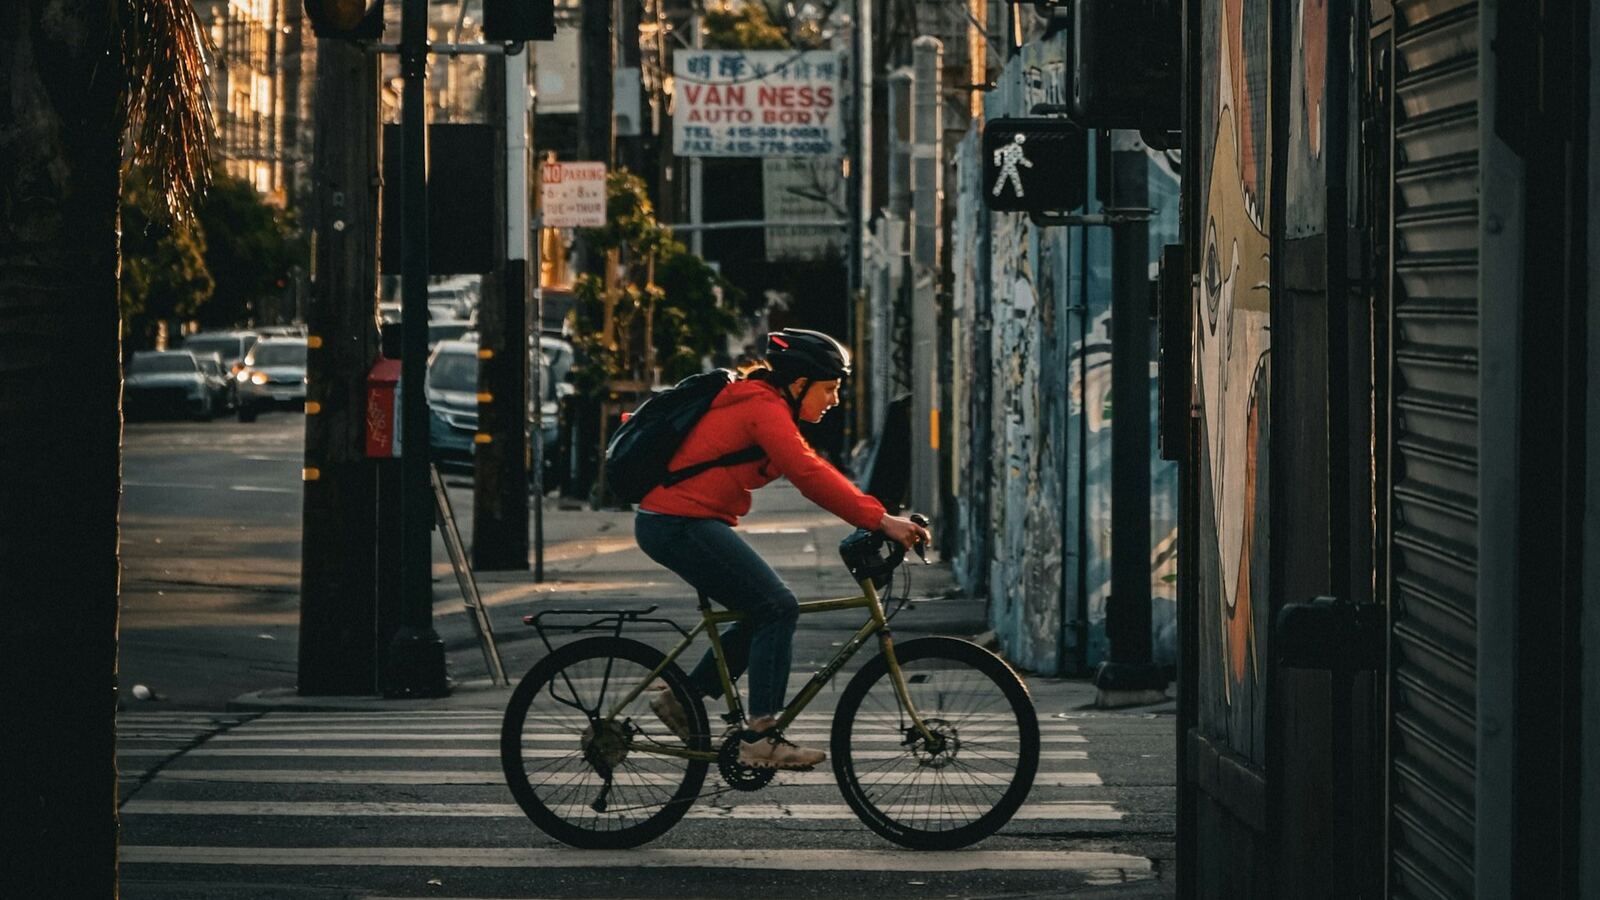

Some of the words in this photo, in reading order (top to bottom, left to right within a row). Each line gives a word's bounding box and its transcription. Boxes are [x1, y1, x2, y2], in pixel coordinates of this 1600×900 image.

[684, 84, 746, 107] VAN
[758, 86, 834, 108] NESS
[688, 109, 753, 123] AUTO
[763, 110, 829, 125] BODY
[542, 165, 561, 182] NO
[564, 168, 605, 180] PARKING
